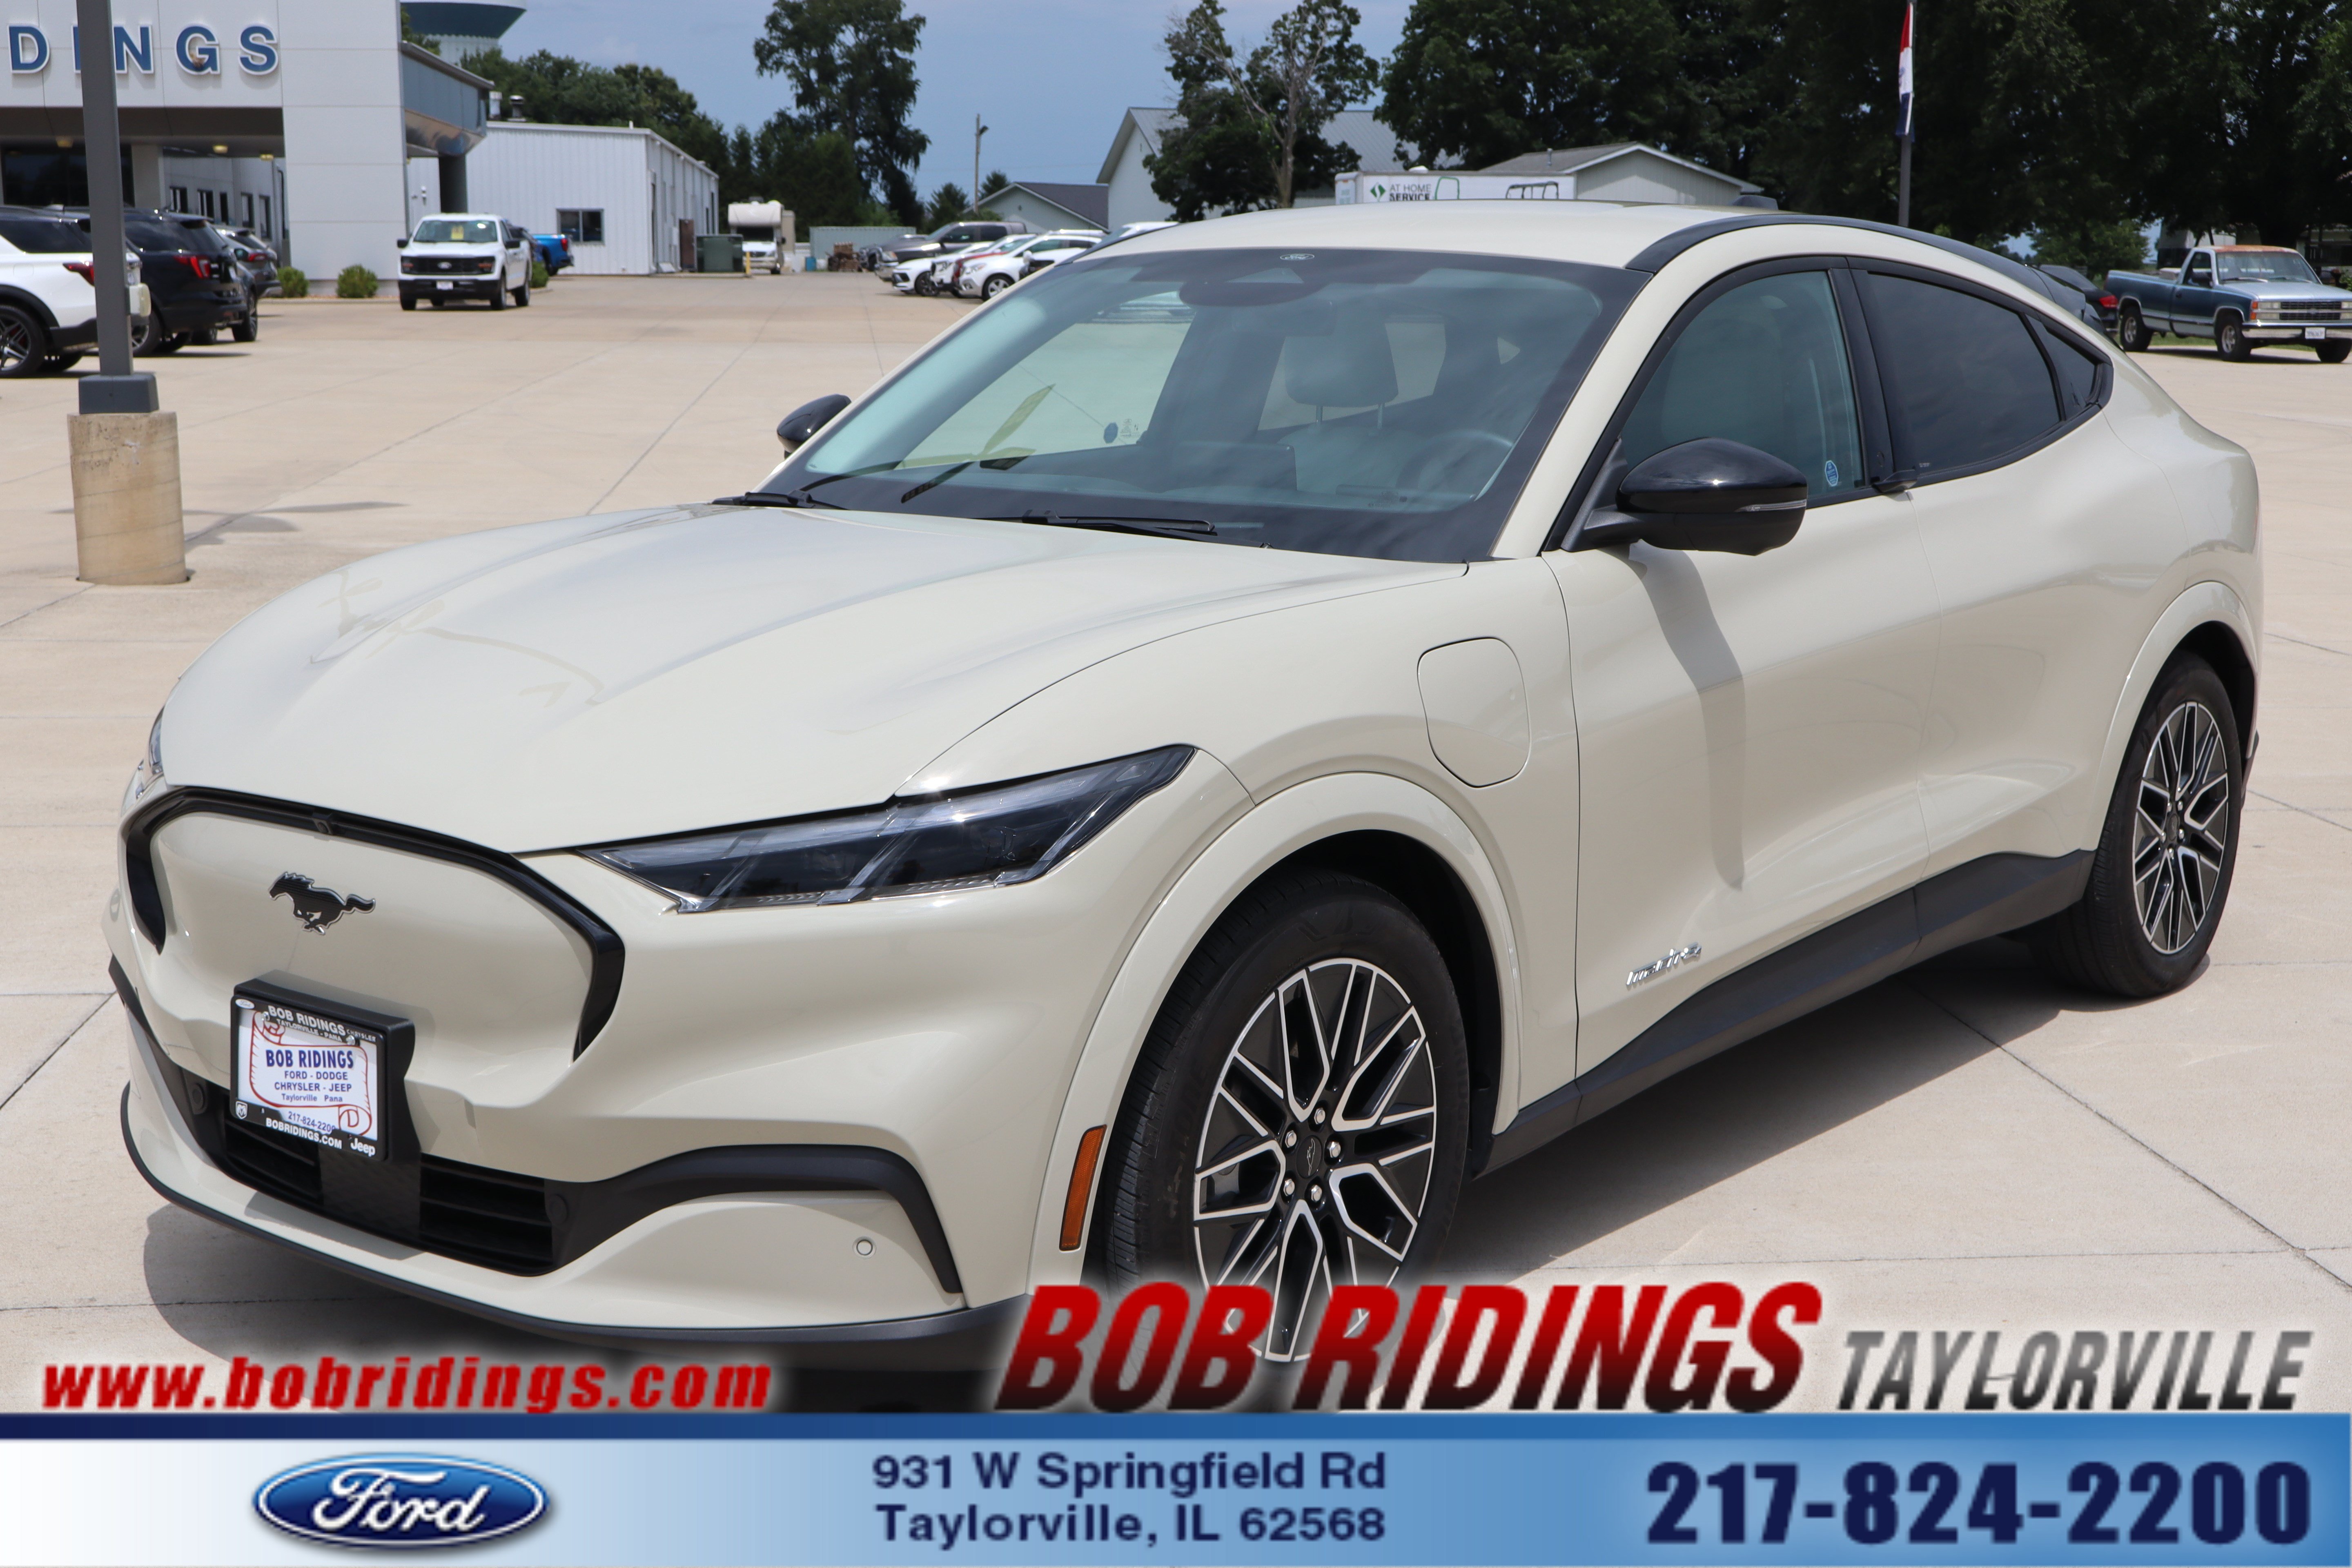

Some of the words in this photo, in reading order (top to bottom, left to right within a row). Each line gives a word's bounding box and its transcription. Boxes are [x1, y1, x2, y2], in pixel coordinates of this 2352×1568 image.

[1389, 183, 1401, 192] AT
[1403, 183, 1431, 192] HOME
[1389, 193, 1430, 201] SERVICE
[268, 1005, 294, 1022] BOB
[296, 1012, 346, 1036] RIDINGS
[276, 1018, 319, 1036] TAYLORVILLE
[324, 1032, 342, 1042] PANA
[346, 1029, 376, 1042] CHRYSLER
[266, 1049, 294, 1067] BOB
[298, 1050, 354, 1069] RIDINGS
[285, 1071, 307, 1079] FORD
[316, 1071, 348, 1080] DODGE
[274, 1082, 320, 1091] CHRYSLER
[329, 1083, 352, 1092] JEEP
[281, 1093, 317, 1102] Taylorville
[265, 1117, 343, 1149] BOBRIDINGS.COM
[350, 1138, 376, 1157] Jeep
